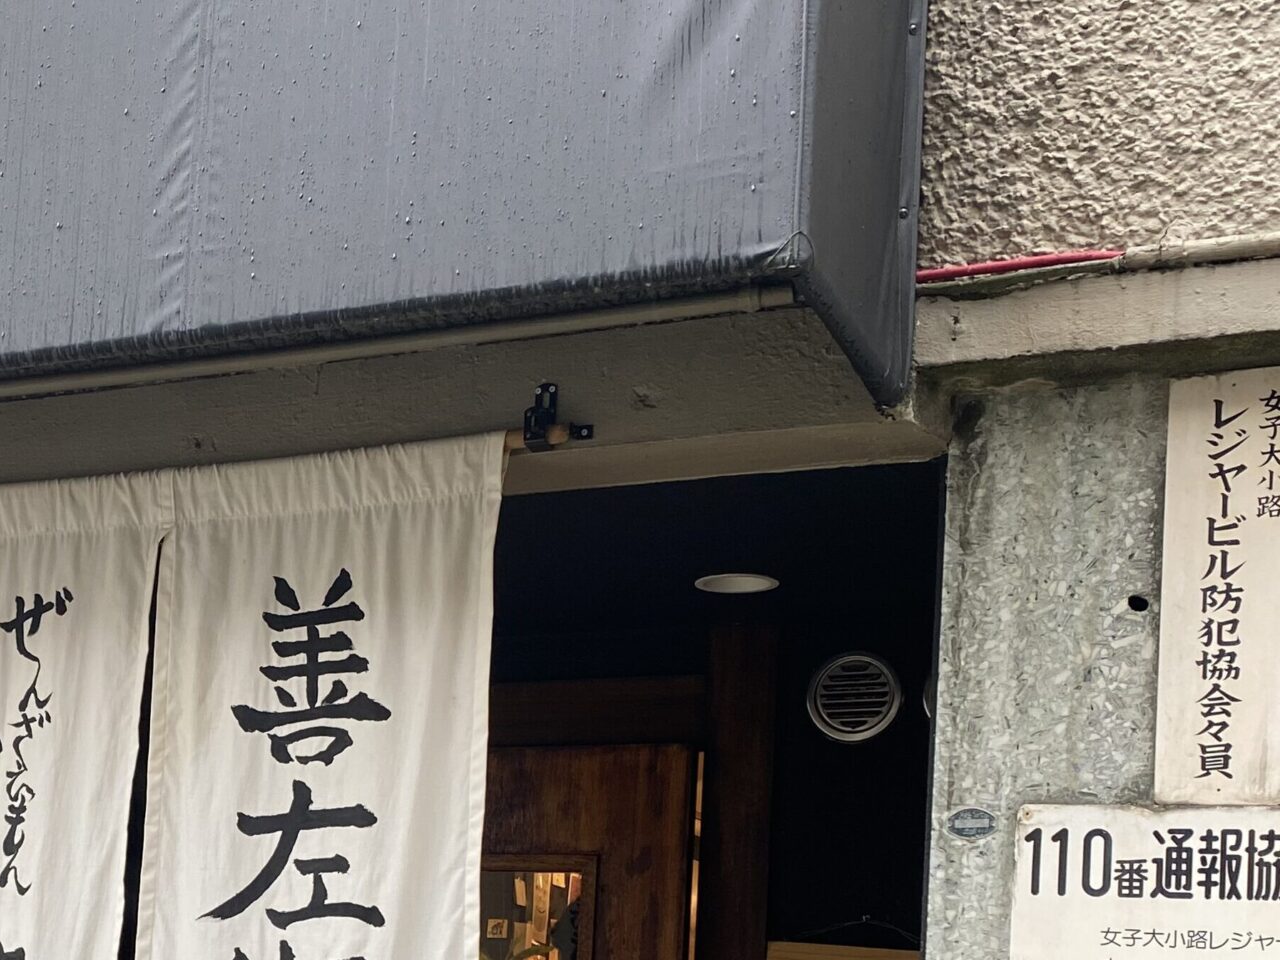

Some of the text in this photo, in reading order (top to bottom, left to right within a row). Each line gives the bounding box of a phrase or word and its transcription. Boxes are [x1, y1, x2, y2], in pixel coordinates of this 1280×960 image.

[1195, 398, 1250, 779] レジャービル防犯協会々員
